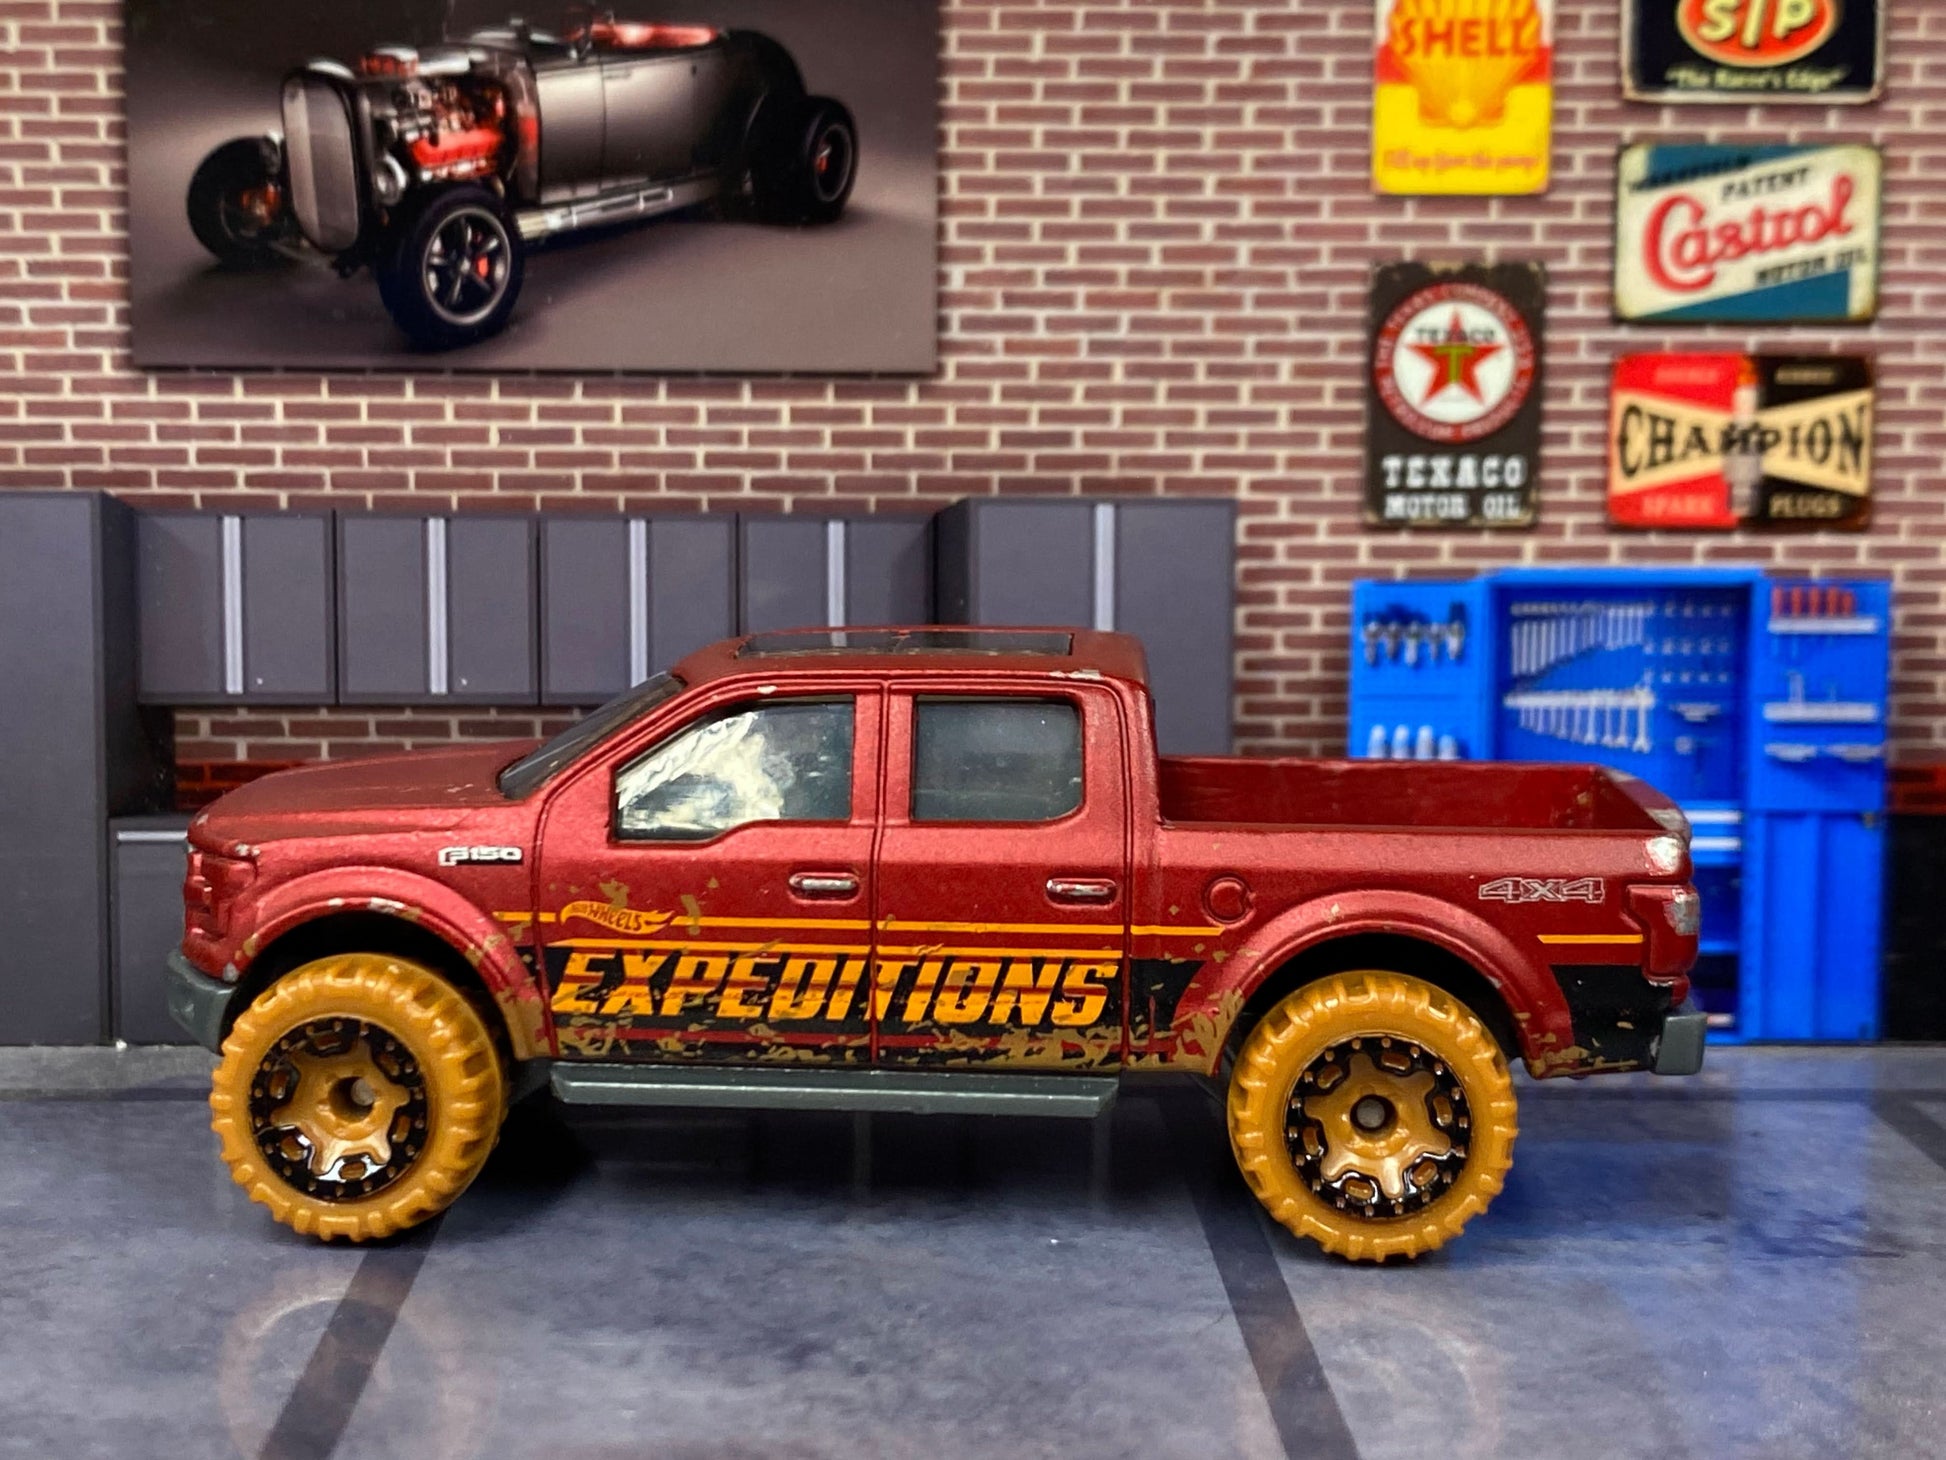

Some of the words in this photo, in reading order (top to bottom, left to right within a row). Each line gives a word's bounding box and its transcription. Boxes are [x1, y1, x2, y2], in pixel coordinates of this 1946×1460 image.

[1400, 18, 1530, 58] SHELL
[1721, 166, 1810, 201] PATENT
[1642, 172, 1855, 293] Castrol
[1617, 401, 1868, 479] CHAMPION
[1382, 454, 1527, 488] TEXACO
[1384, 492, 1470, 519] MOTOR
[1481, 492, 1521, 519] OIL
[551, 951, 1119, 1026] EXPEDITIONS
